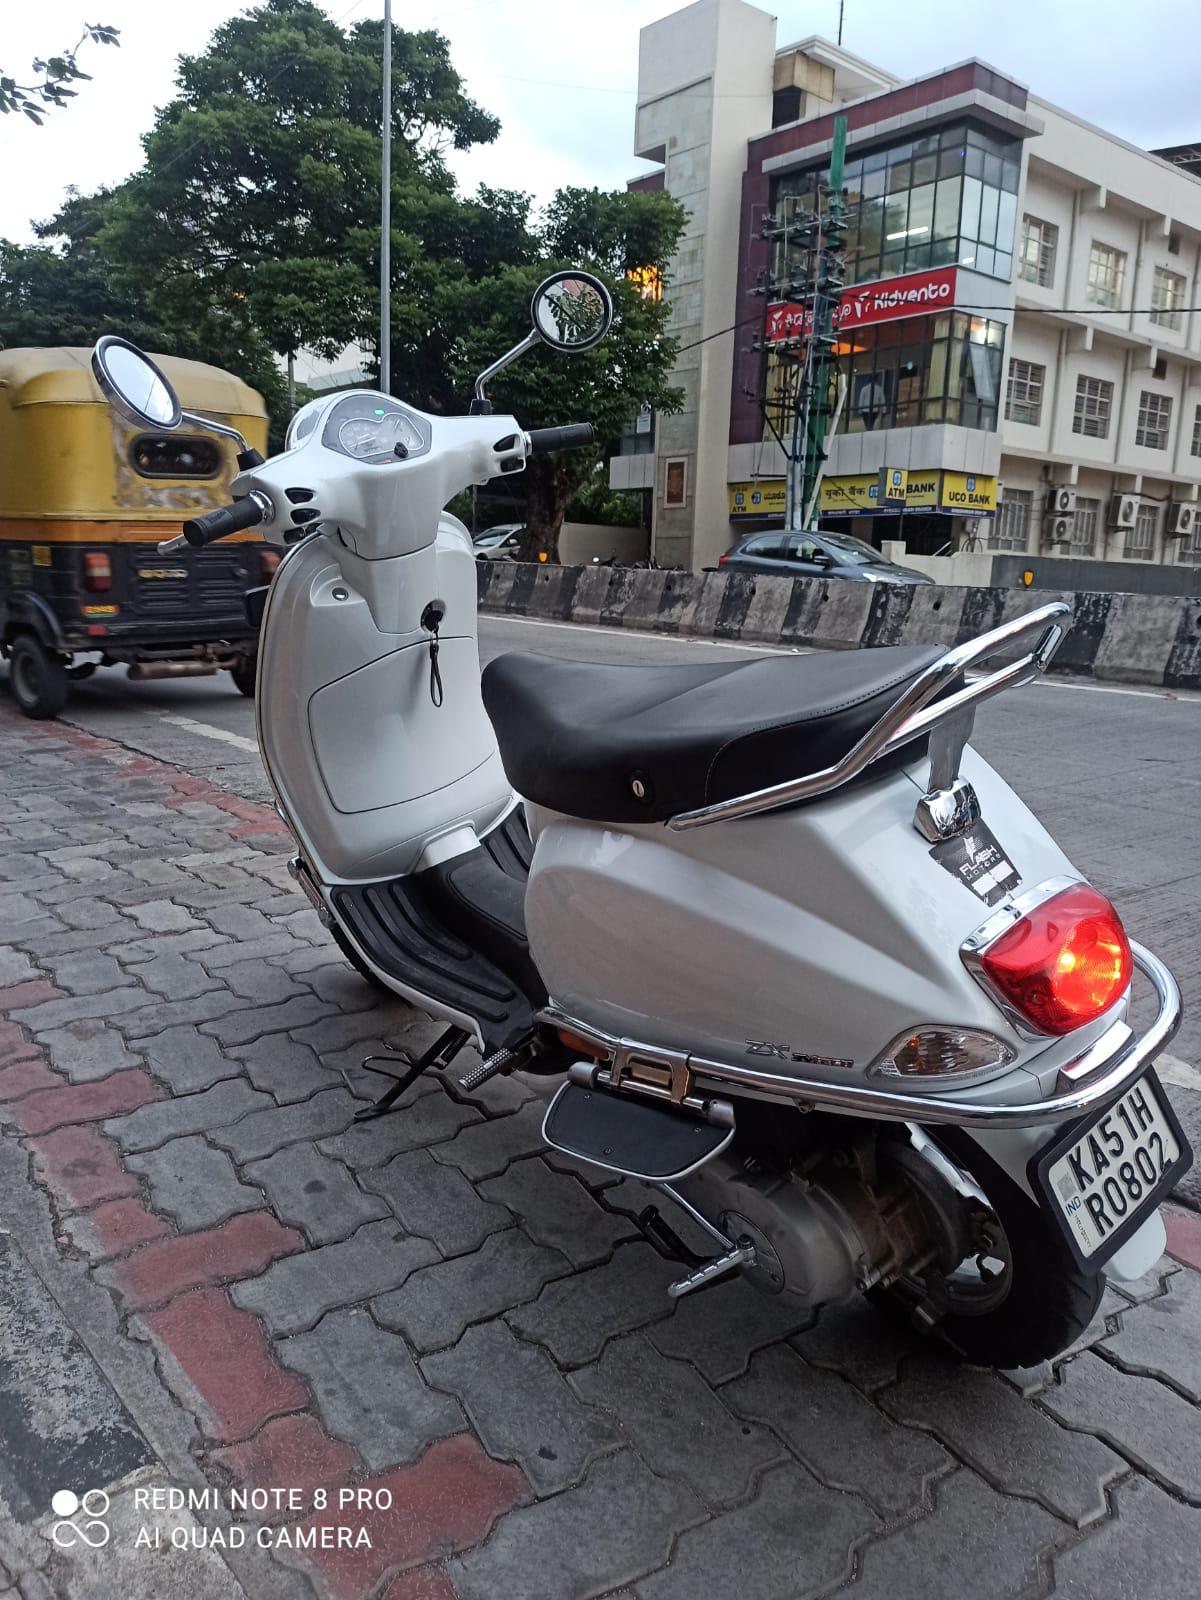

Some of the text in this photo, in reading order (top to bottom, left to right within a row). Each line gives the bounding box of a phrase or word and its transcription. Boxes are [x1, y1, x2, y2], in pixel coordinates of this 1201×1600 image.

[874, 283, 951, 311] Kidvento
[888, 487, 905, 499] ATM
[906, 483, 935, 494] BANK
[949, 491, 991, 505] UCO BANK
[745, 1039, 791, 1060] ZX
[1067, 1086, 1154, 1193] KA51H
[1084, 1131, 1173, 1237] R0802
[1065, 1195, 1082, 1217] IND
